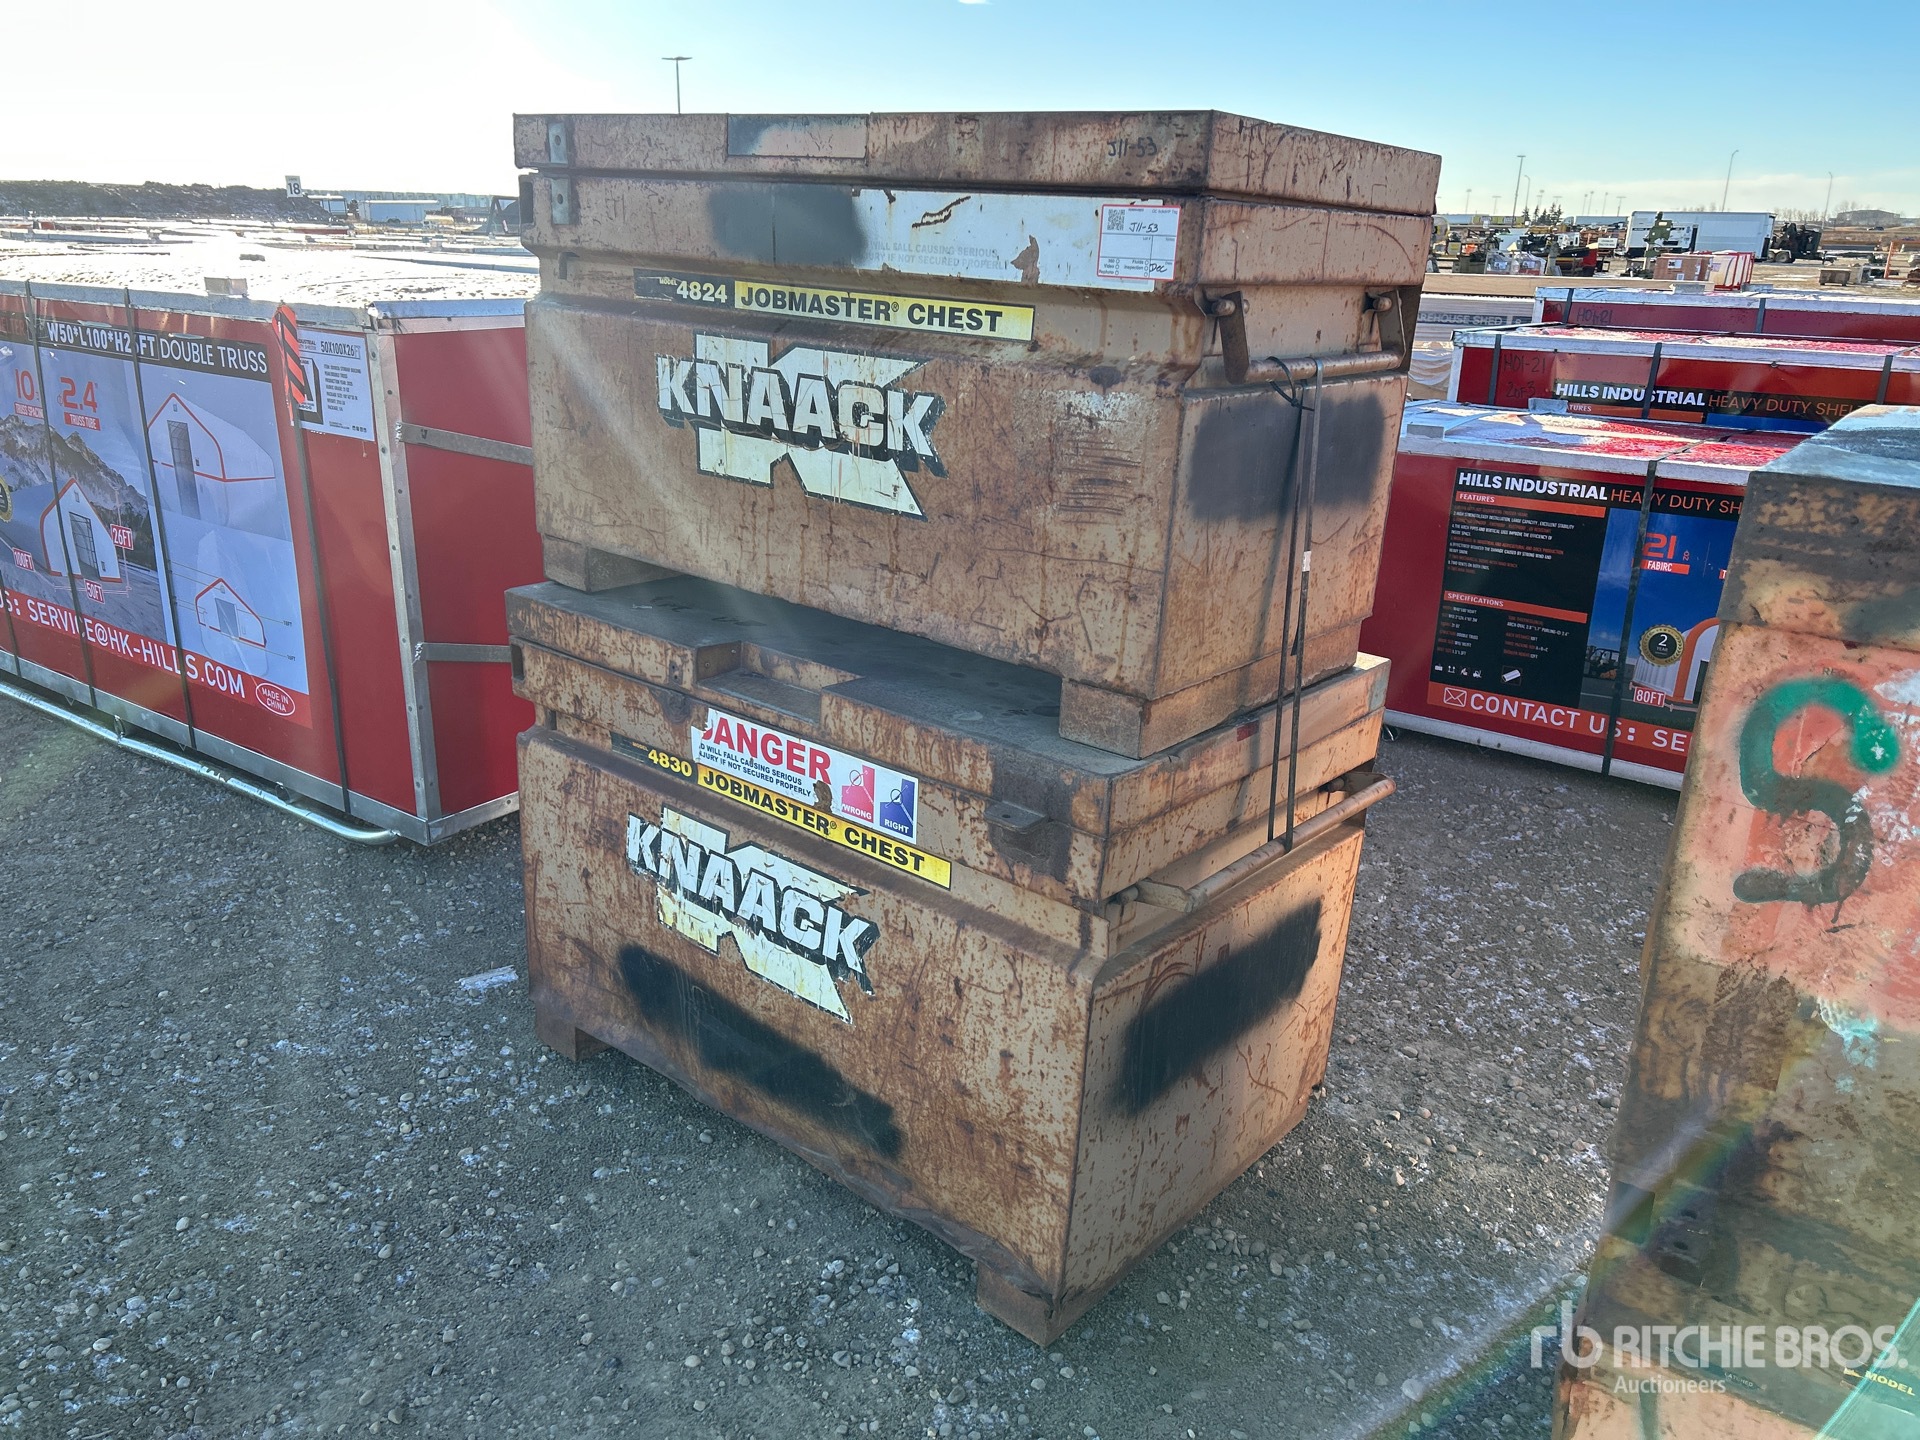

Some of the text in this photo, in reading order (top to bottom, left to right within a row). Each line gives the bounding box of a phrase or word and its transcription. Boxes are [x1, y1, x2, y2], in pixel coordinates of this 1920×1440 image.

[288, 183, 300, 194] 18
[1129, 222, 1158, 233] J11-53
[958, 247, 997, 258] SERIOUS
[918, 256, 959, 266] SECURED
[677, 281, 727, 303] 4824
[908, 303, 1002, 332] CHEST
[1473, 316, 1503, 325] SHED
[160, 339, 214, 365] DOUBLE
[217, 346, 267, 374] TRUSS
[1556, 383, 1599, 398] HILLS
[1709, 394, 1762, 410] HEAVY
[1766, 399, 1812, 414] DUTY
[29, 405, 44, 419] SPACIN
[656, 352, 940, 462] KNAACK
[1567, 404, 1591, 412] TURES
[1459, 472, 1502, 488] HILLS
[1505, 477, 1607, 500] INDUSTRIAL
[1669, 495, 1715, 511] DUTY
[1460, 494, 1494, 502] FEATURES
[113, 528, 132, 548] 26FT
[1643, 533, 1676, 559] 21
[1648, 560, 1672, 572] FABIRC
[1448, 593, 1503, 607] SPECIFICATIONS
[1658, 634, 1667, 646] 2
[262, 687, 289, 705] MADE IN
[1637, 690, 1664, 705] 80FT
[267, 698, 286, 712] CHINA
[1471, 694, 1580, 728] CONTACT
[707, 745, 722, 757] WILL
[723, 752, 739, 763] FALL
[740, 757, 770, 774] CAUSING
[772, 768, 802, 785] SERIOUS
[728, 761, 741, 771] NOT
[743, 766, 774, 784] SECURED
[775, 778, 811, 797] PROPERLY
[648, 749, 692, 776] 4830
[845, 827, 925, 872] CHEST
[842, 804, 872, 819] WRONG
[884, 819, 909, 833] RIGHT
[628, 811, 875, 980] KNAACK
[1724, 1372, 1754, 1387] LATHED
[1865, 1371, 1916, 1396] MODEL
